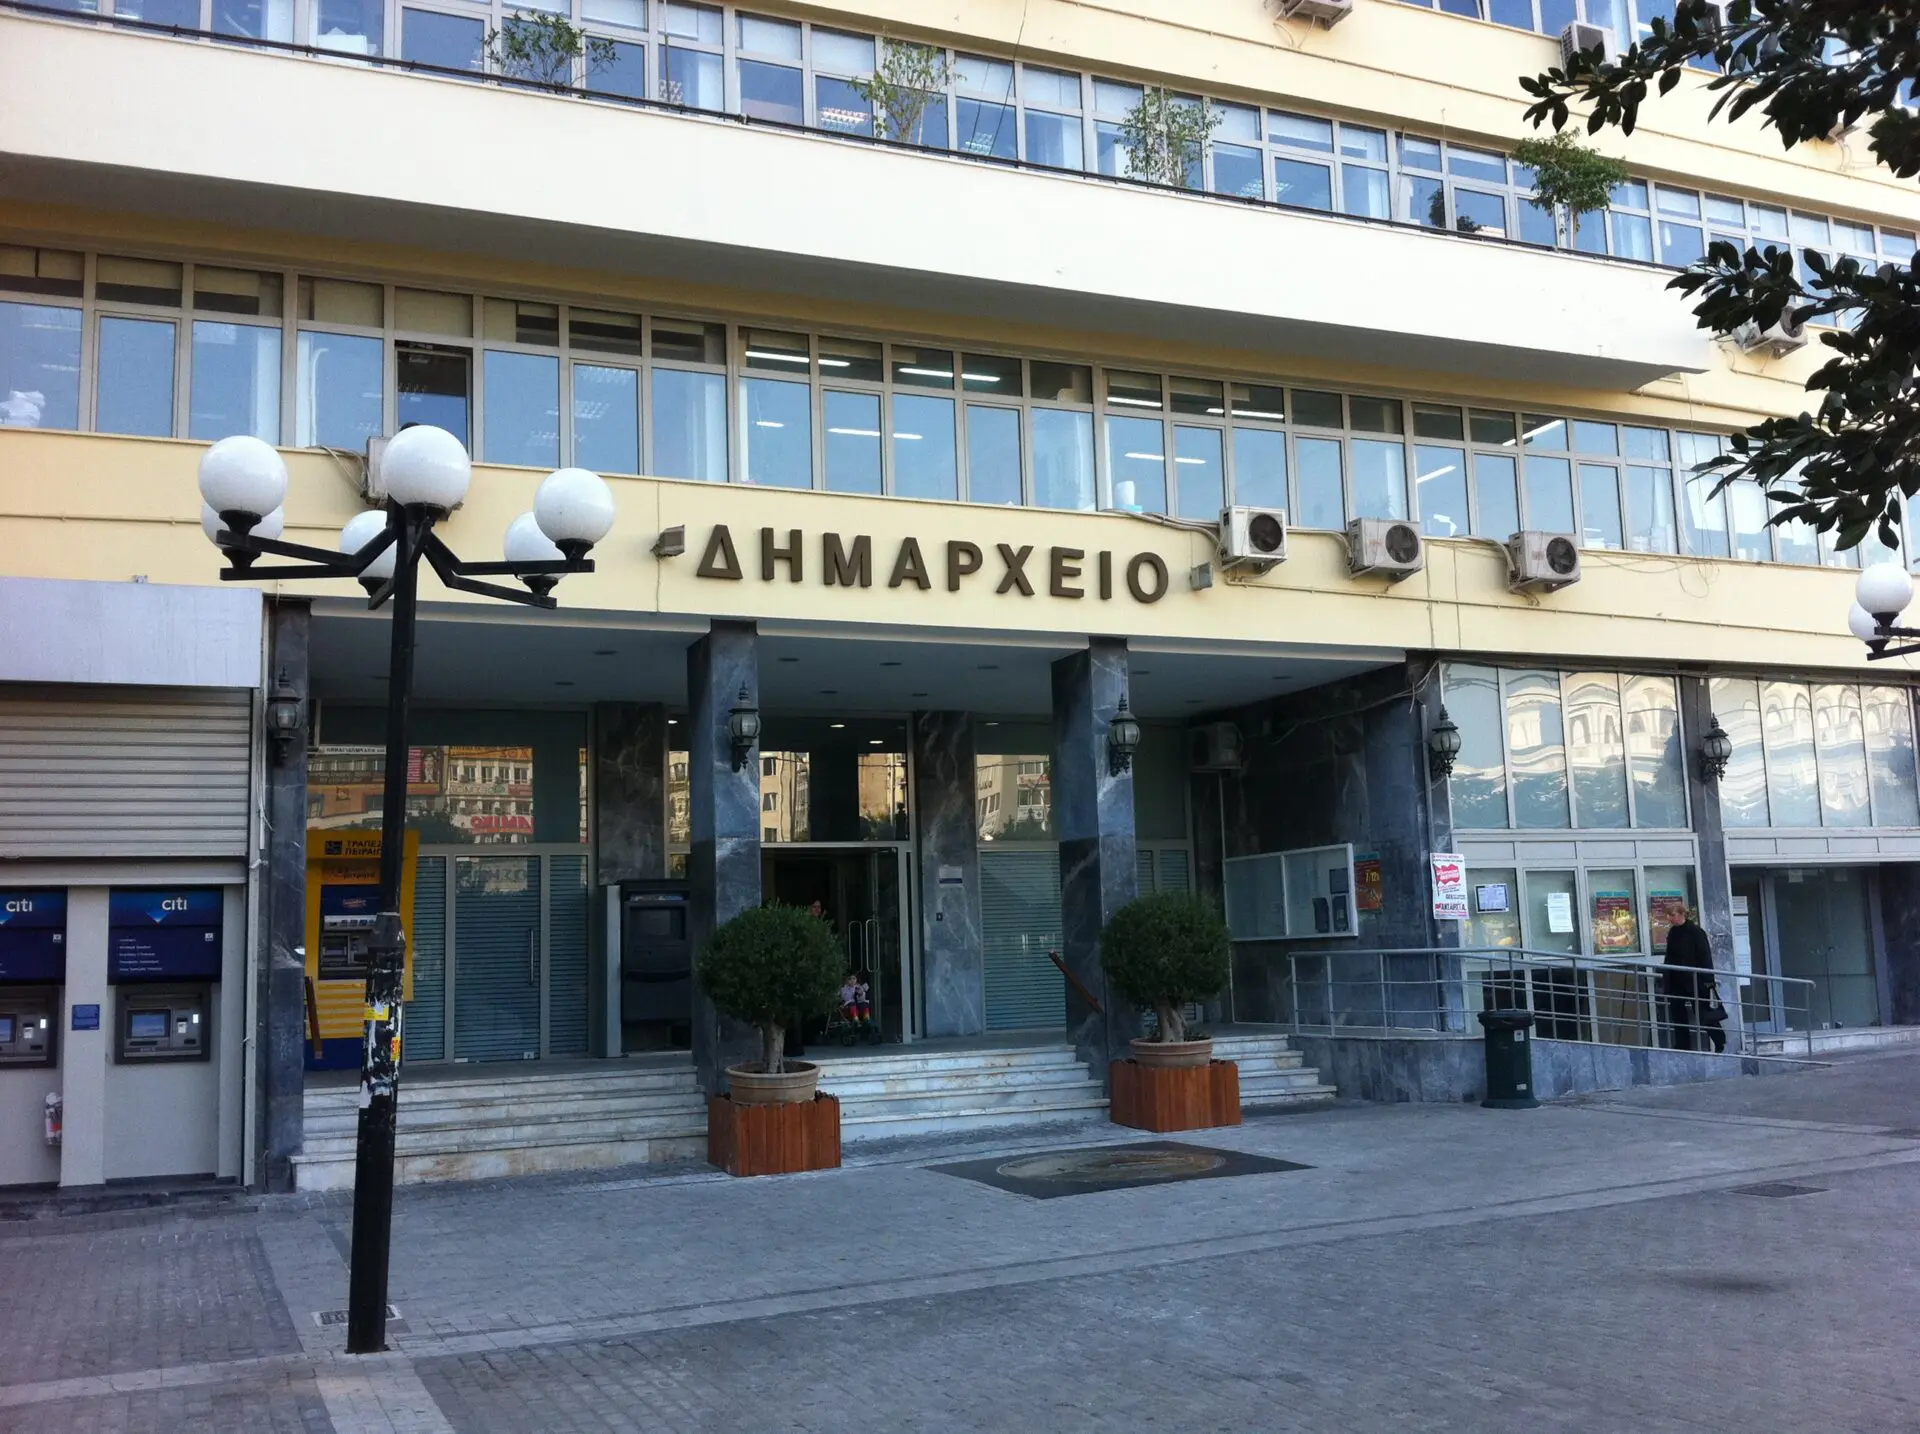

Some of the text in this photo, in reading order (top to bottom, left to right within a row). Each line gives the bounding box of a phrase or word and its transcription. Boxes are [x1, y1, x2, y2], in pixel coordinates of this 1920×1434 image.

[697, 524, 1169, 604] ΔΗΜΑΡΧΕΙΟ
[6, 898, 33, 912] citi
[161, 897, 188, 911] citi
